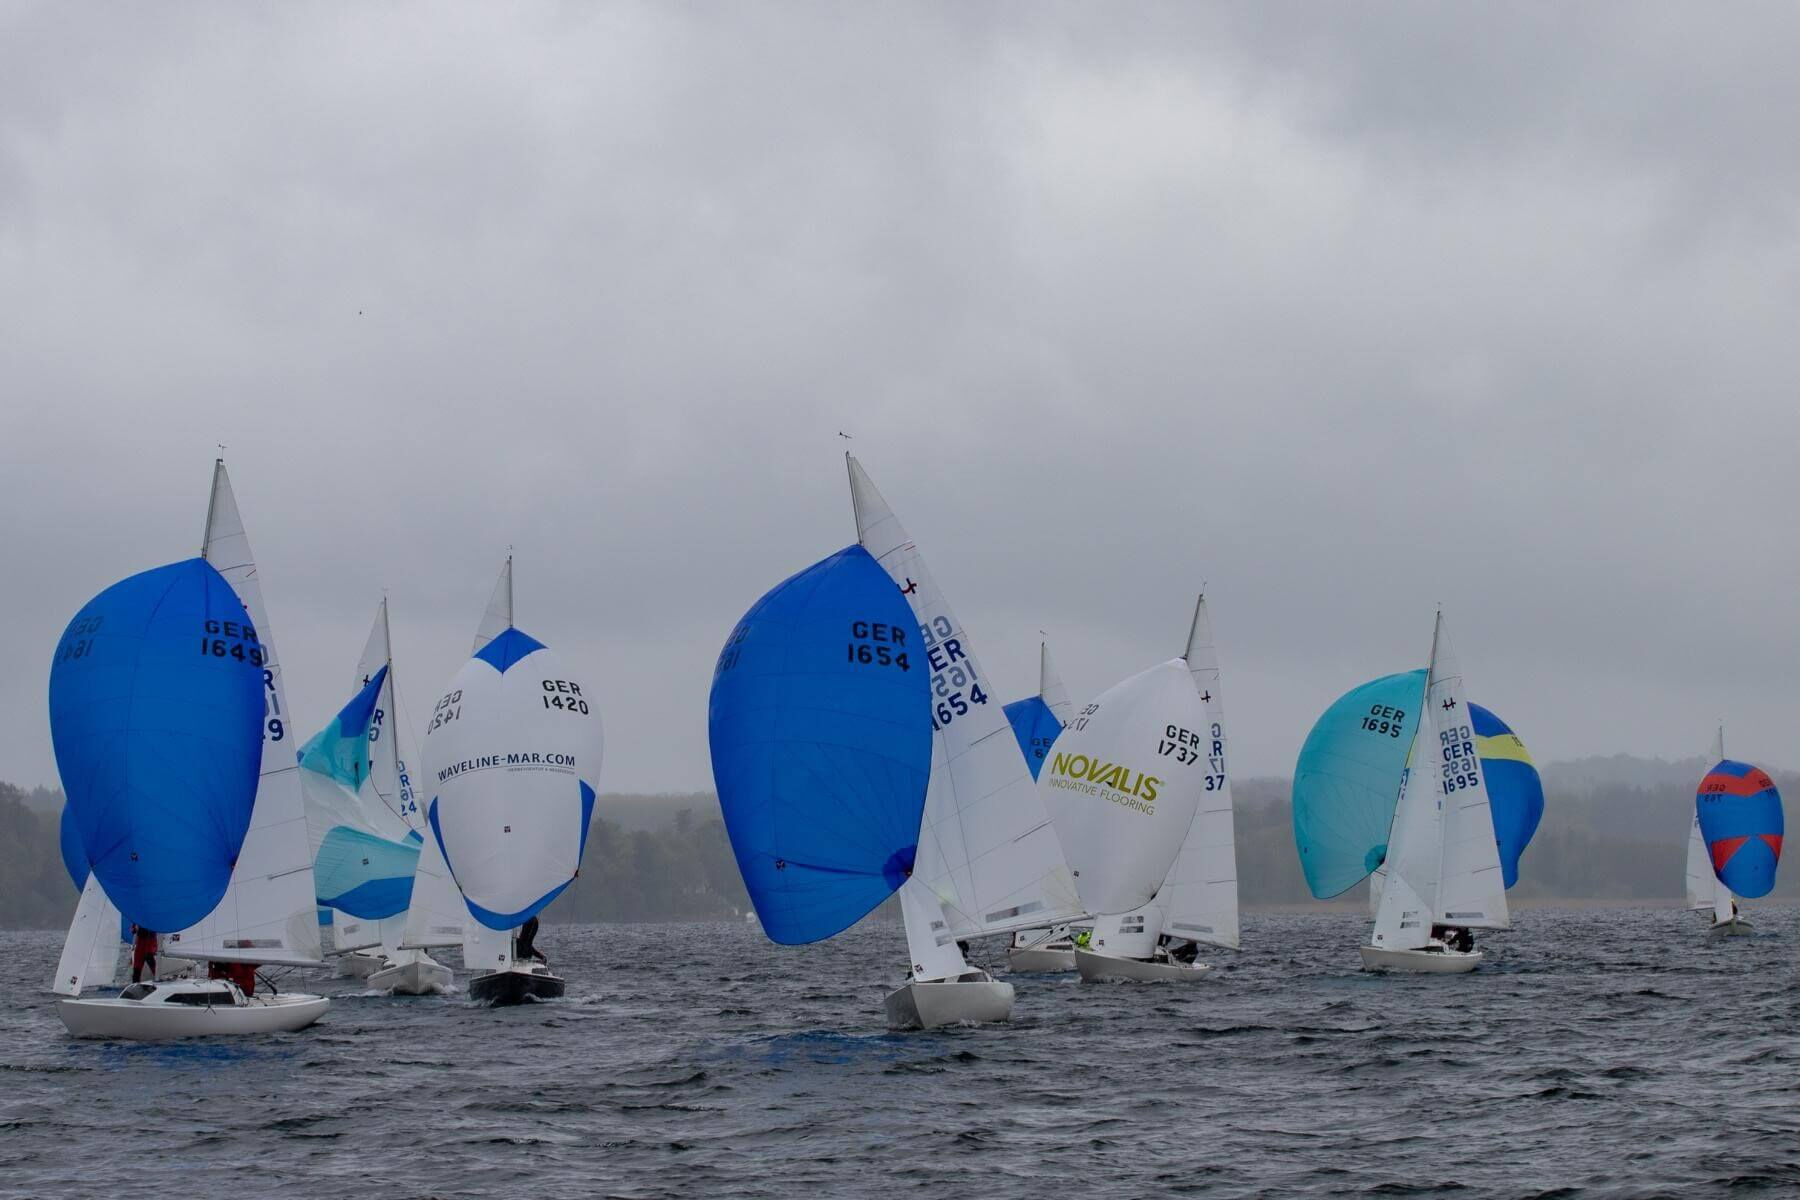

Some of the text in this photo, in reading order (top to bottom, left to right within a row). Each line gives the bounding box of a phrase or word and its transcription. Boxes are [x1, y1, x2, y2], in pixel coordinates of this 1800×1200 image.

[205, 619, 258, 643] GER
[853, 621, 907, 646] GER
[202, 637, 262, 667] 1649
[848, 644, 910, 672] 1654
[928, 639, 965, 672] ER
[542, 680, 583, 697] GER
[543, 695, 589, 715] 1420
[1370, 704, 1405, 723] GER
[1166, 724, 1200, 750] GER
[1361, 717, 1402, 738] 1695
[1158, 740, 1199, 766] 1737
[1443, 741, 1475, 762] GER
[438, 753, 575, 781] WAVELINE-MAR.COM
[1051, 753, 1159, 802] NOVALIS
[1442, 772, 1479, 795] 1695
[1100, 788, 1154, 816] FLOORING
